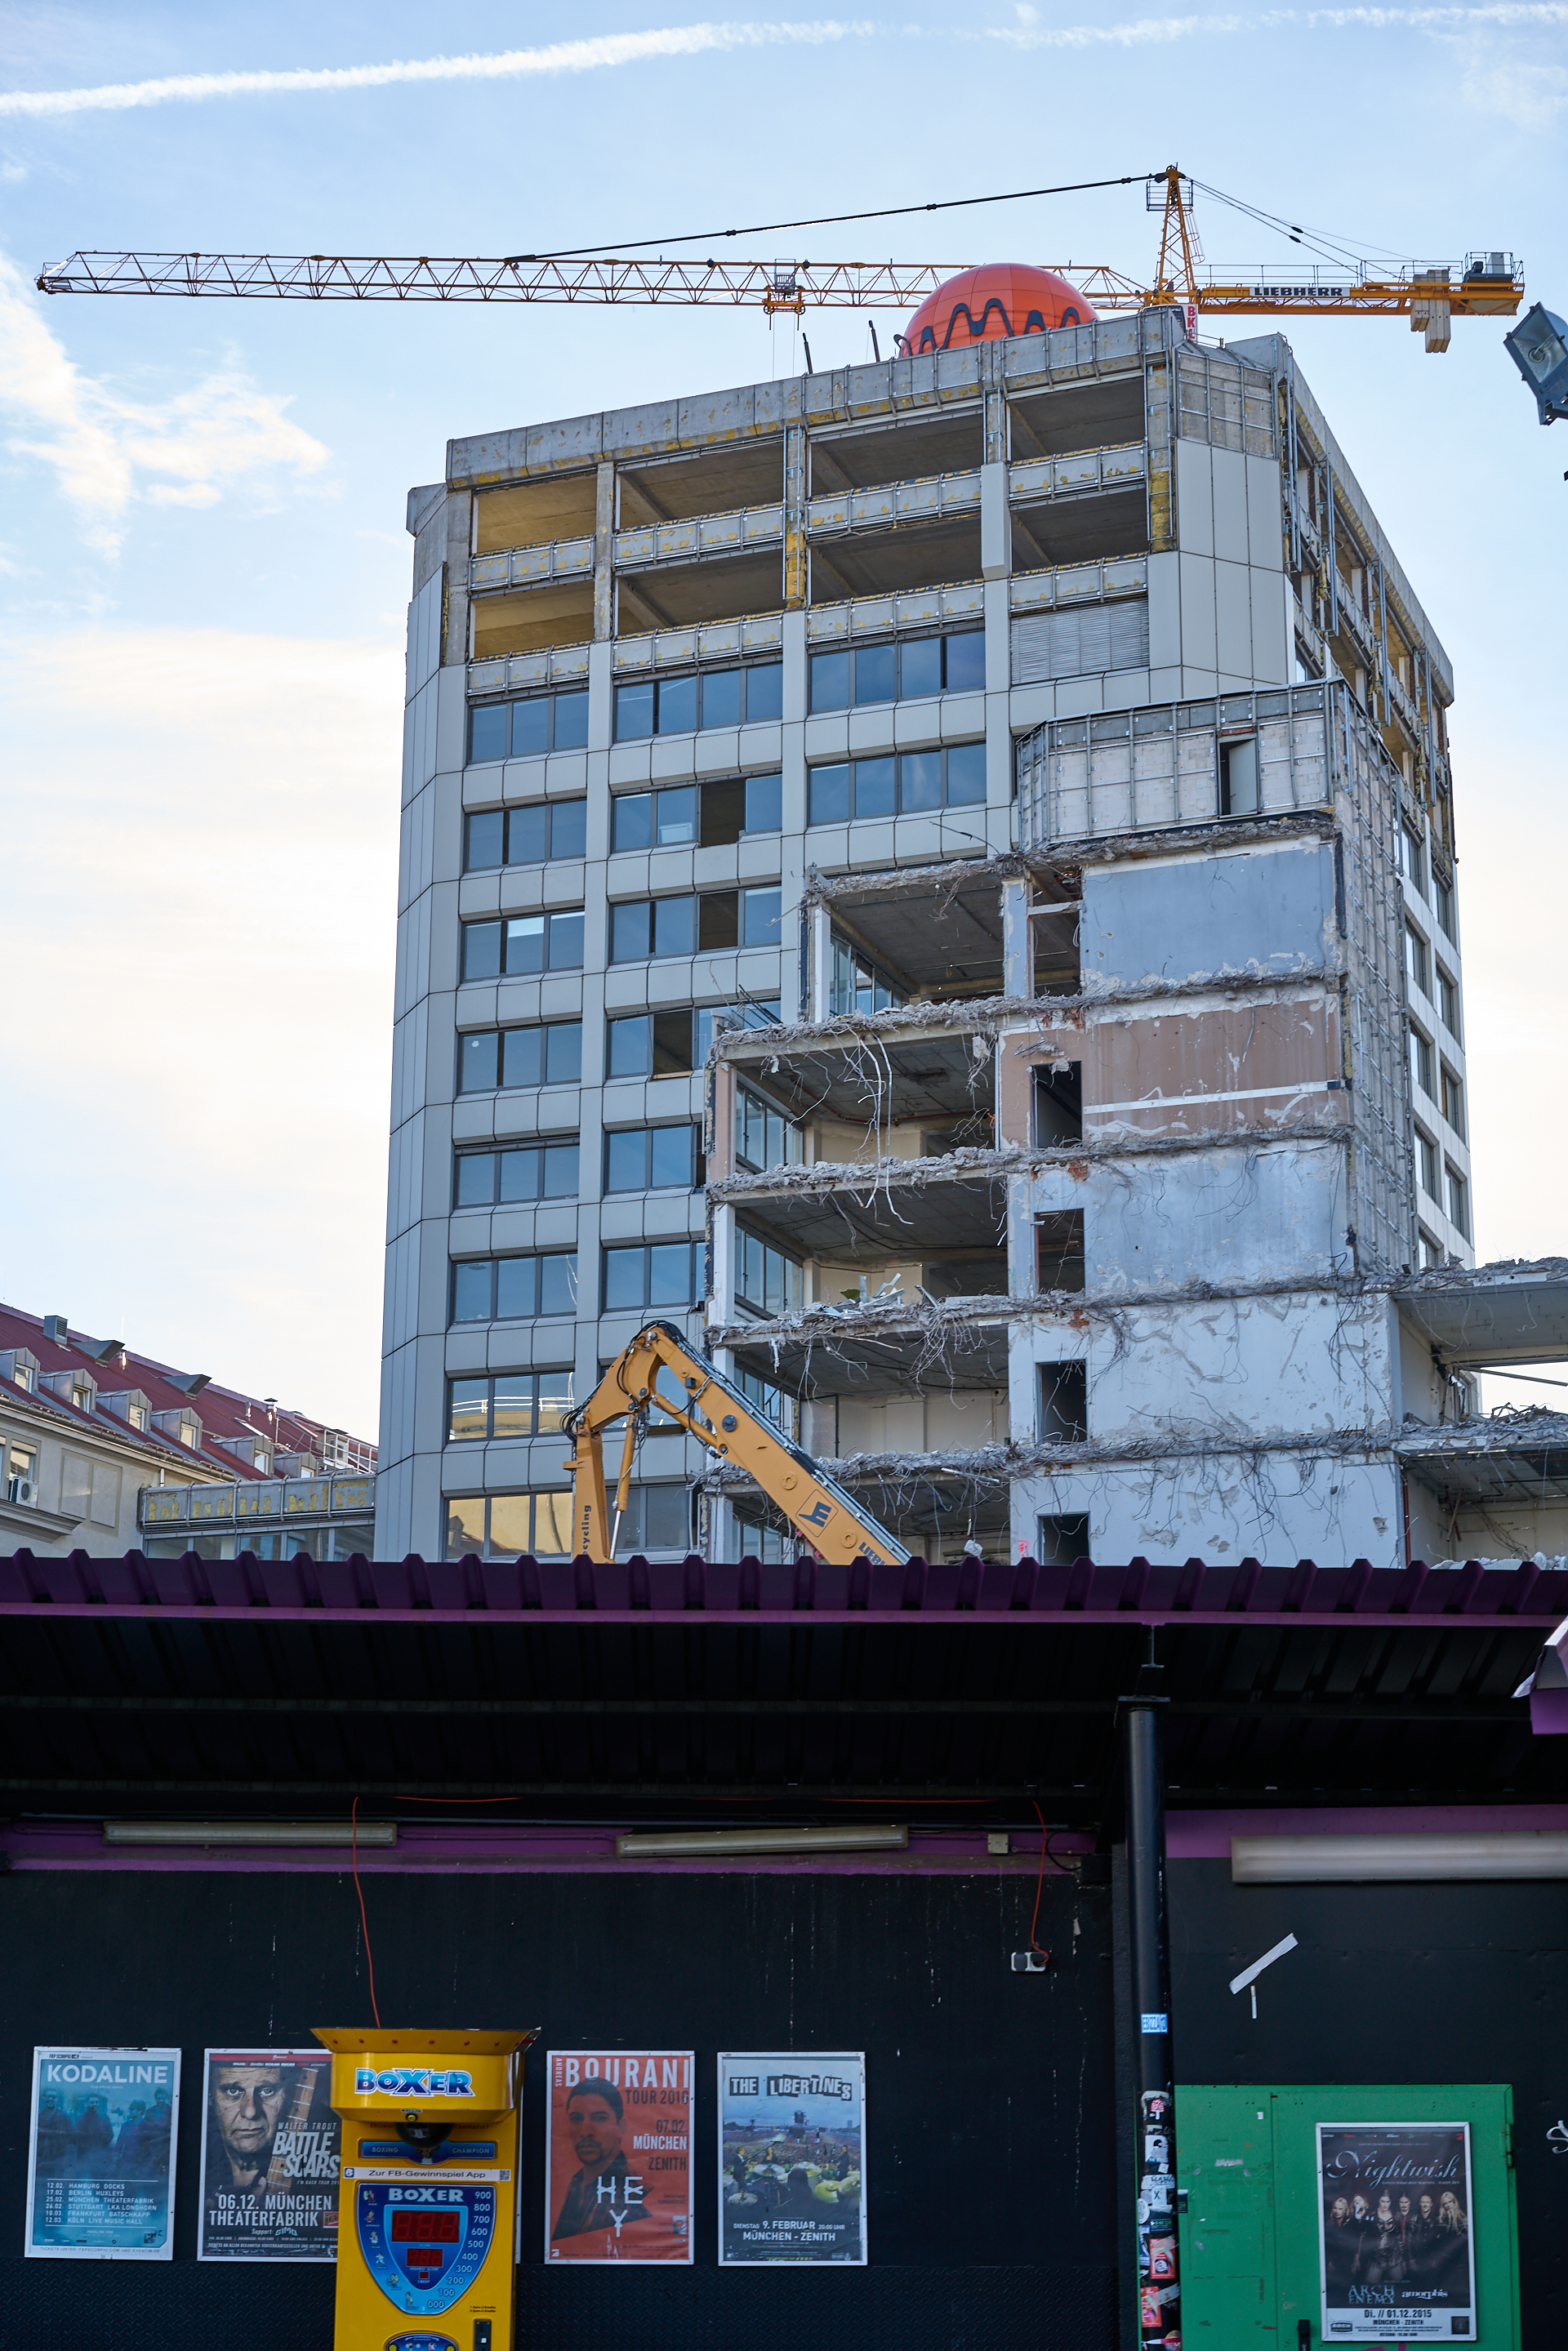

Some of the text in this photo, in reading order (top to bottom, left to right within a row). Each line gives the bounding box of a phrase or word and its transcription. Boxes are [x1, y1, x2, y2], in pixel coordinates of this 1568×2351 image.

[1255, 288, 1342, 296] LIEBHERR
[1187, 306, 1195, 339] BKL
[858, 1542, 888, 1565] LIEB
[47, 2064, 168, 2083] KODALINE
[565, 2058, 689, 2088] BOURANI
[731, 2077, 851, 2099] THE LIBERTINES
[626, 2090, 689, 2104] TOUR 2016
[656, 2120, 687, 2133] 07.02.
[272, 2132, 335, 2155] BATTLE
[633, 2134, 687, 2149] MÜNCHEN
[283, 2154, 340, 2178] SCARS
[648, 2157, 686, 2170] ZENITH
[1326, 2150, 1460, 2189] Nightwish
[219, 2192, 332, 2210] 06.12. MÜNCHEN
[209, 2210, 318, 2226] THEATERFABRIK
[763, 2221, 770, 2229] 9.
[772, 2221, 816, 2230] FEBRUAR
[743, 2230, 792, 2240] MÜNCHEN
[800, 2232, 835, 2241] ZENITH
[1348, 2285, 1395, 2296] ARCH
[1401, 2289, 1448, 2300] amorphis
[1348, 2295, 1395, 2304] ENEMY
[1364, 2309, 1375, 2318] Di.
[1387, 2309, 1432, 2318] 01.12.2015
